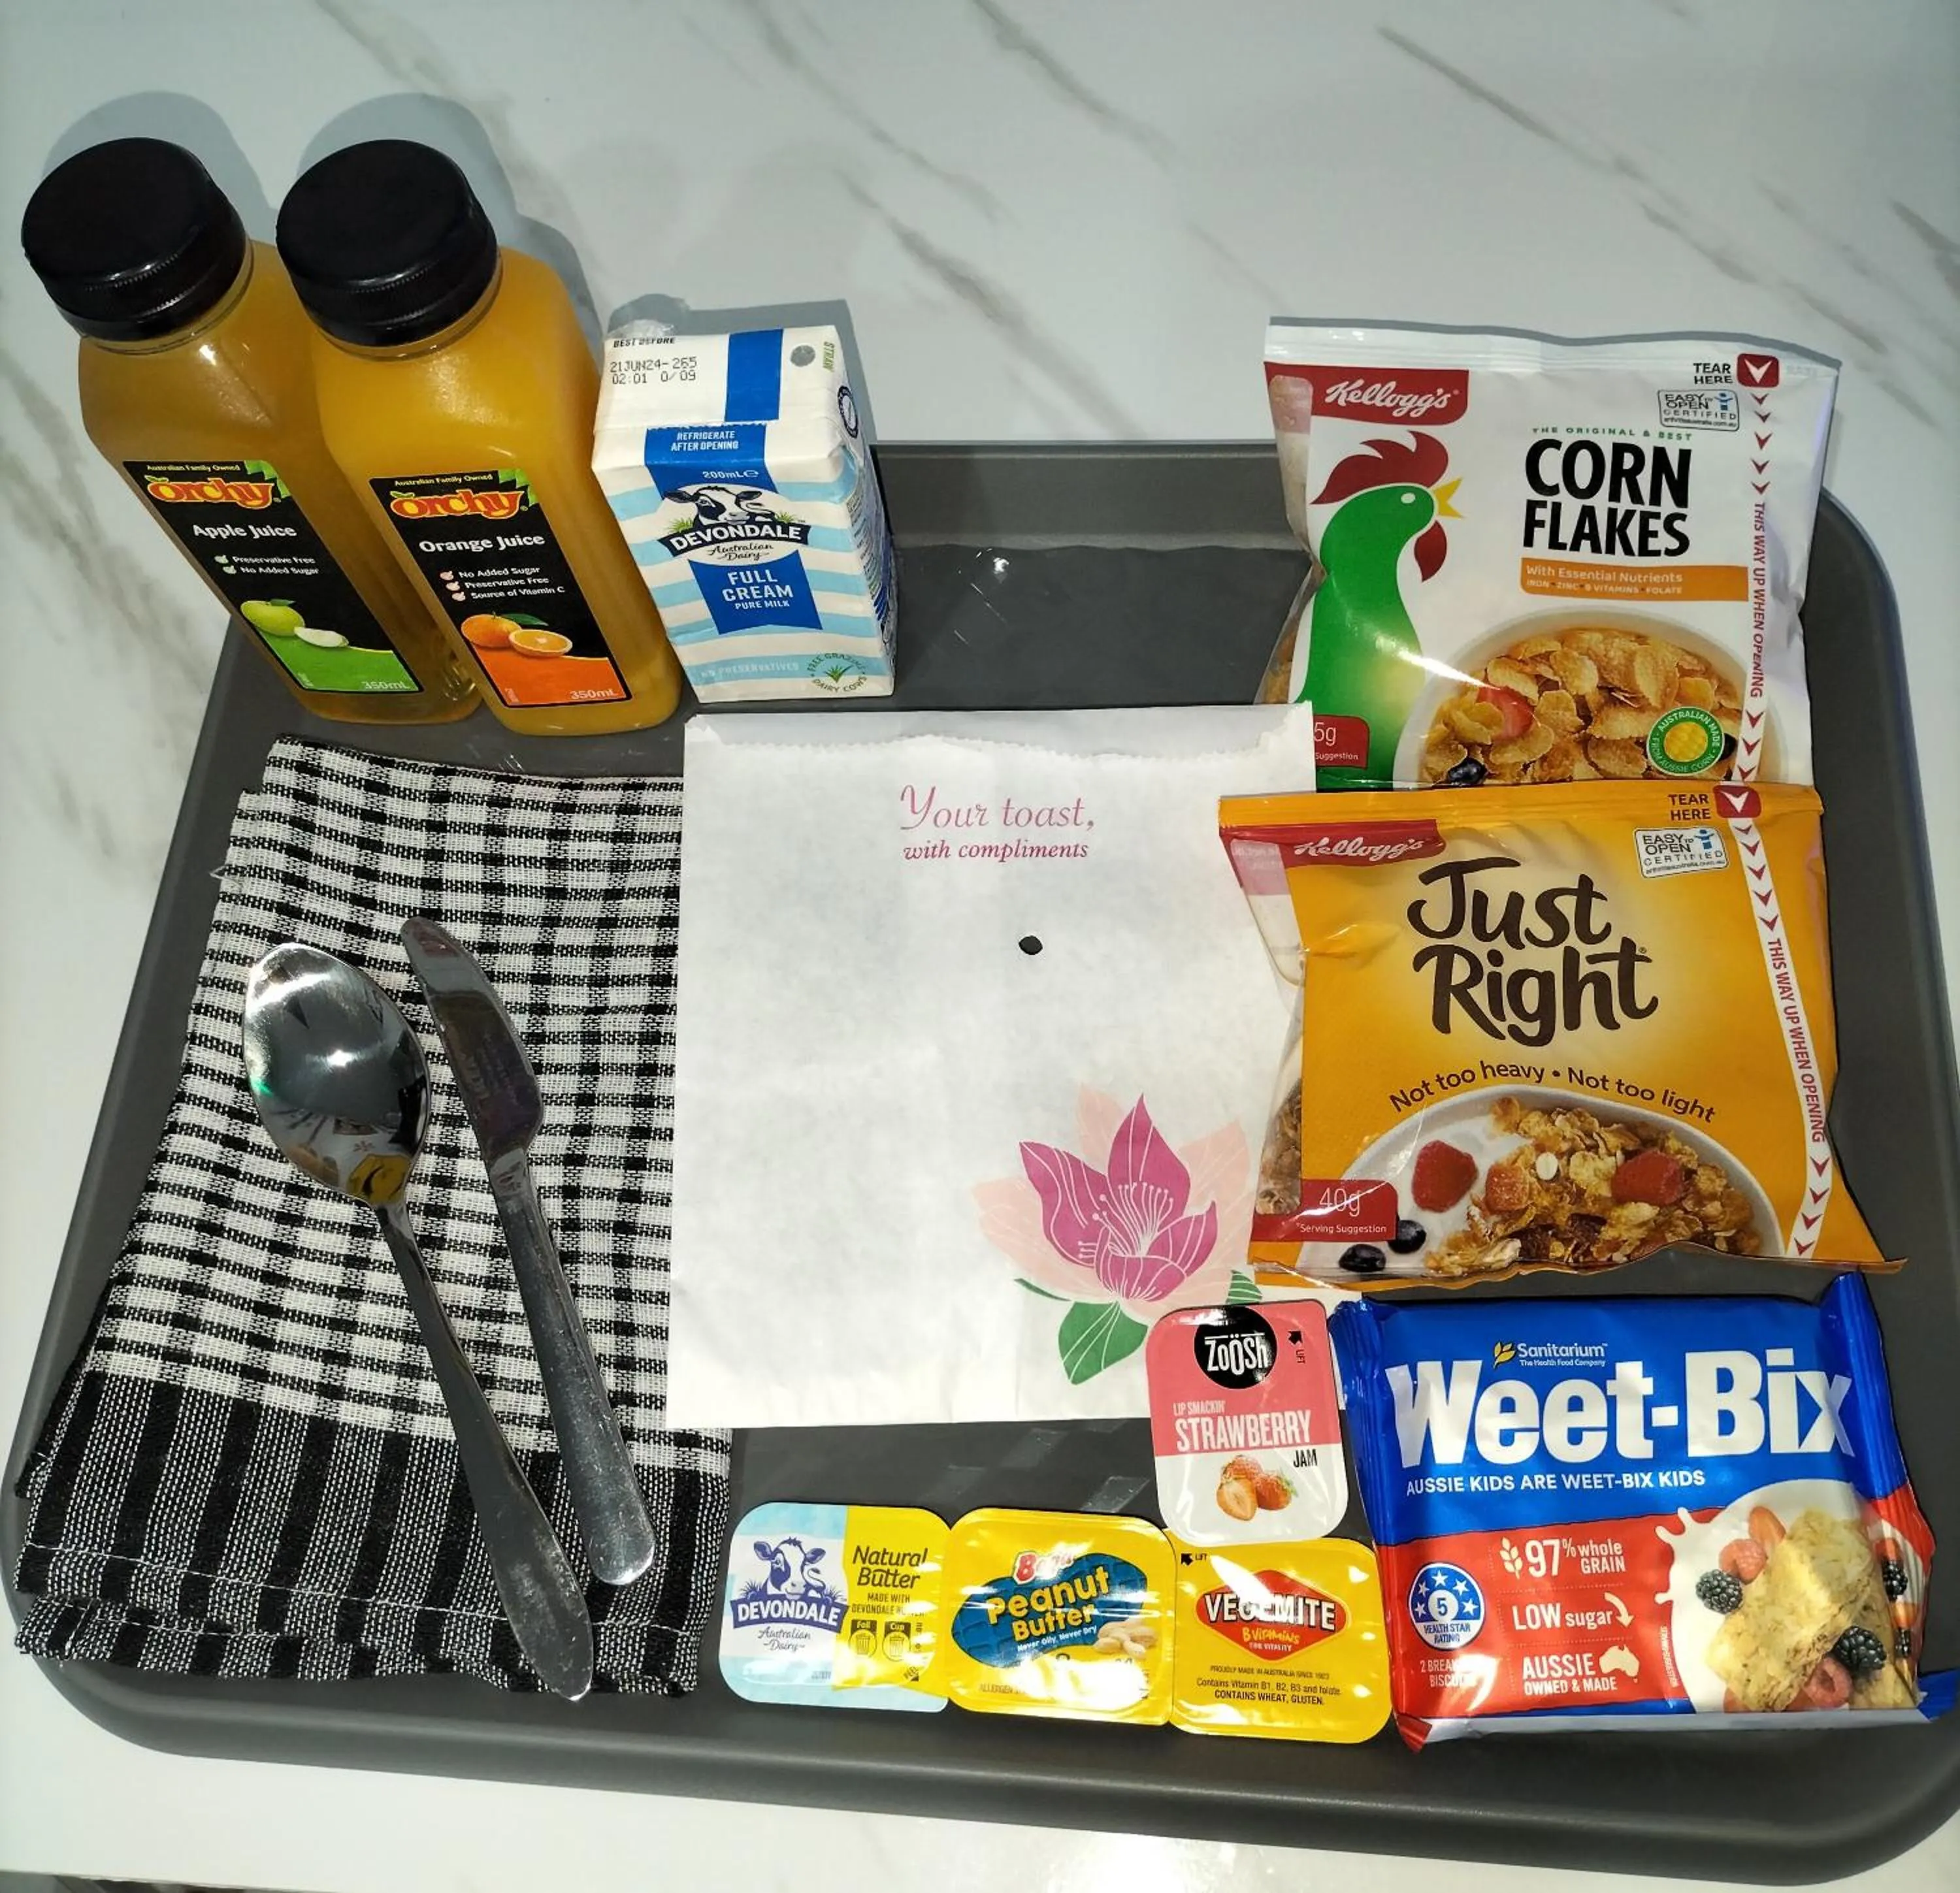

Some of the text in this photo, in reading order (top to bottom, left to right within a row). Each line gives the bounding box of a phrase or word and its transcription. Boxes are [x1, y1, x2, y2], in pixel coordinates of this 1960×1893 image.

[613, 338, 636, 348] BEST
[1693, 363, 1731, 374] TEAR
[612, 373, 647, 384] 02:01
[1694, 376, 1733, 384] HERE
[1325, 379, 1450, 417] Kellogg's
[1665, 393, 1705, 402] EASY
[1663, 409, 1737, 420] CERTIFIED
[677, 430, 736, 441] REFRIGERATE
[1566, 428, 1636, 436] ORIGINAL
[1658, 432, 1691, 440] BEST
[672, 440, 739, 451] AFTER OPENING
[465, 474, 493, 482] Owned
[1525, 438, 1692, 508] CORN
[193, 525, 297, 540] Apple Juice
[1523, 499, 1690, 557] FLAKES
[419, 534, 546, 552] Orange Juice
[670, 523, 802, 550] DEVONDALE
[708, 542, 774, 555] Australian
[724, 551, 761, 562] Dairy
[233, 556, 316, 565] Preservative Free
[291, 566, 319, 575] Sugar
[459, 566, 540, 579] No Added Sugar
[727, 569, 778, 586] FULL
[1526, 564, 1683, 583] With Essential Nutrients
[465, 579, 525, 589] Preservative
[1593, 584, 1682, 594] VITAMINS FOLATE
[471, 591, 505, 600] Source
[518, 587, 555, 595] Vitamin
[722, 585, 794, 602] CREAM
[1750, 502, 1766, 698] THIS WAY UP WHEN OPENING
[735, 599, 791, 610] PURE MILK
[361, 681, 410, 690] 350mL
[570, 689, 618, 700] 350mL
[1658, 710, 1711, 732] AUSTRALIAN
[900, 784, 1094, 831] Your toast,
[1668, 794, 1709, 805] TEAR
[1671, 809, 1711, 821] HERE
[1642, 833, 1684, 845] EASY
[904, 839, 1089, 863] with compliments
[1294, 836, 1424, 862] Kellogg's
[1645, 843, 1691, 855] OPEN
[1644, 850, 1723, 866] CERTIFIED
[1407, 856, 1612, 950] Just
[1413, 935, 1659, 1046] Right
[1768, 938, 1825, 1143] THIS WAY UP WHEN OPENING
[1389, 1060, 1716, 1124] Not too heavy Not too light
[1318, 1188, 1362, 1217] 40g
[1336, 1223, 1387, 1235] Suggestion
[1516, 1342, 1606, 1358] Sanitarium
[1575, 1359, 1605, 1367] Company
[1173, 1402, 1186, 1416] LIP
[1385, 1348, 1855, 1468] Weet-Bix
[1175, 1409, 1311, 1451] STRAWBERRY
[1293, 1449, 1318, 1468] JAM
[1407, 1469, 1706, 1497] AUSSIE KIDS ARE WEET-BIX KIDS
[1576, 1538, 1624, 1556] whole
[853, 1545, 928, 1568] Natural
[1580, 1556, 1625, 1575] GRAIN
[857, 1568, 921, 1589] Butter
[867, 1593, 911, 1603] MADE WITH
[986, 1565, 1109, 1625] Peanut
[737, 1600, 841, 1626] DEVONDALE
[851, 1603, 894, 1615] DEVONDALE
[1204, 1593, 1335, 1632] VEGEMITE
[1437, 1597, 1447, 1617] 5
[1012, 1602, 1095, 1642] Butter
[1512, 1602, 1613, 1630] LOW sugar
[757, 1626, 811, 1640] Australian
[1242, 1626, 1250, 1642] B
[1450, 1623, 1471, 1632] STAR
[768, 1640, 799, 1651] Dairy
[1420, 1660, 1426, 1673] 2
[1522, 1653, 1596, 1679] AUSSIE
[1197, 1677, 1230, 1688] Contains
[1302, 1684, 1317, 1694] and
[1524, 1676, 1618, 1695] OWNED & MADE
[1215, 1690, 1256, 1701] CONTAINS
[1258, 1692, 1289, 1704] WHEAT,
